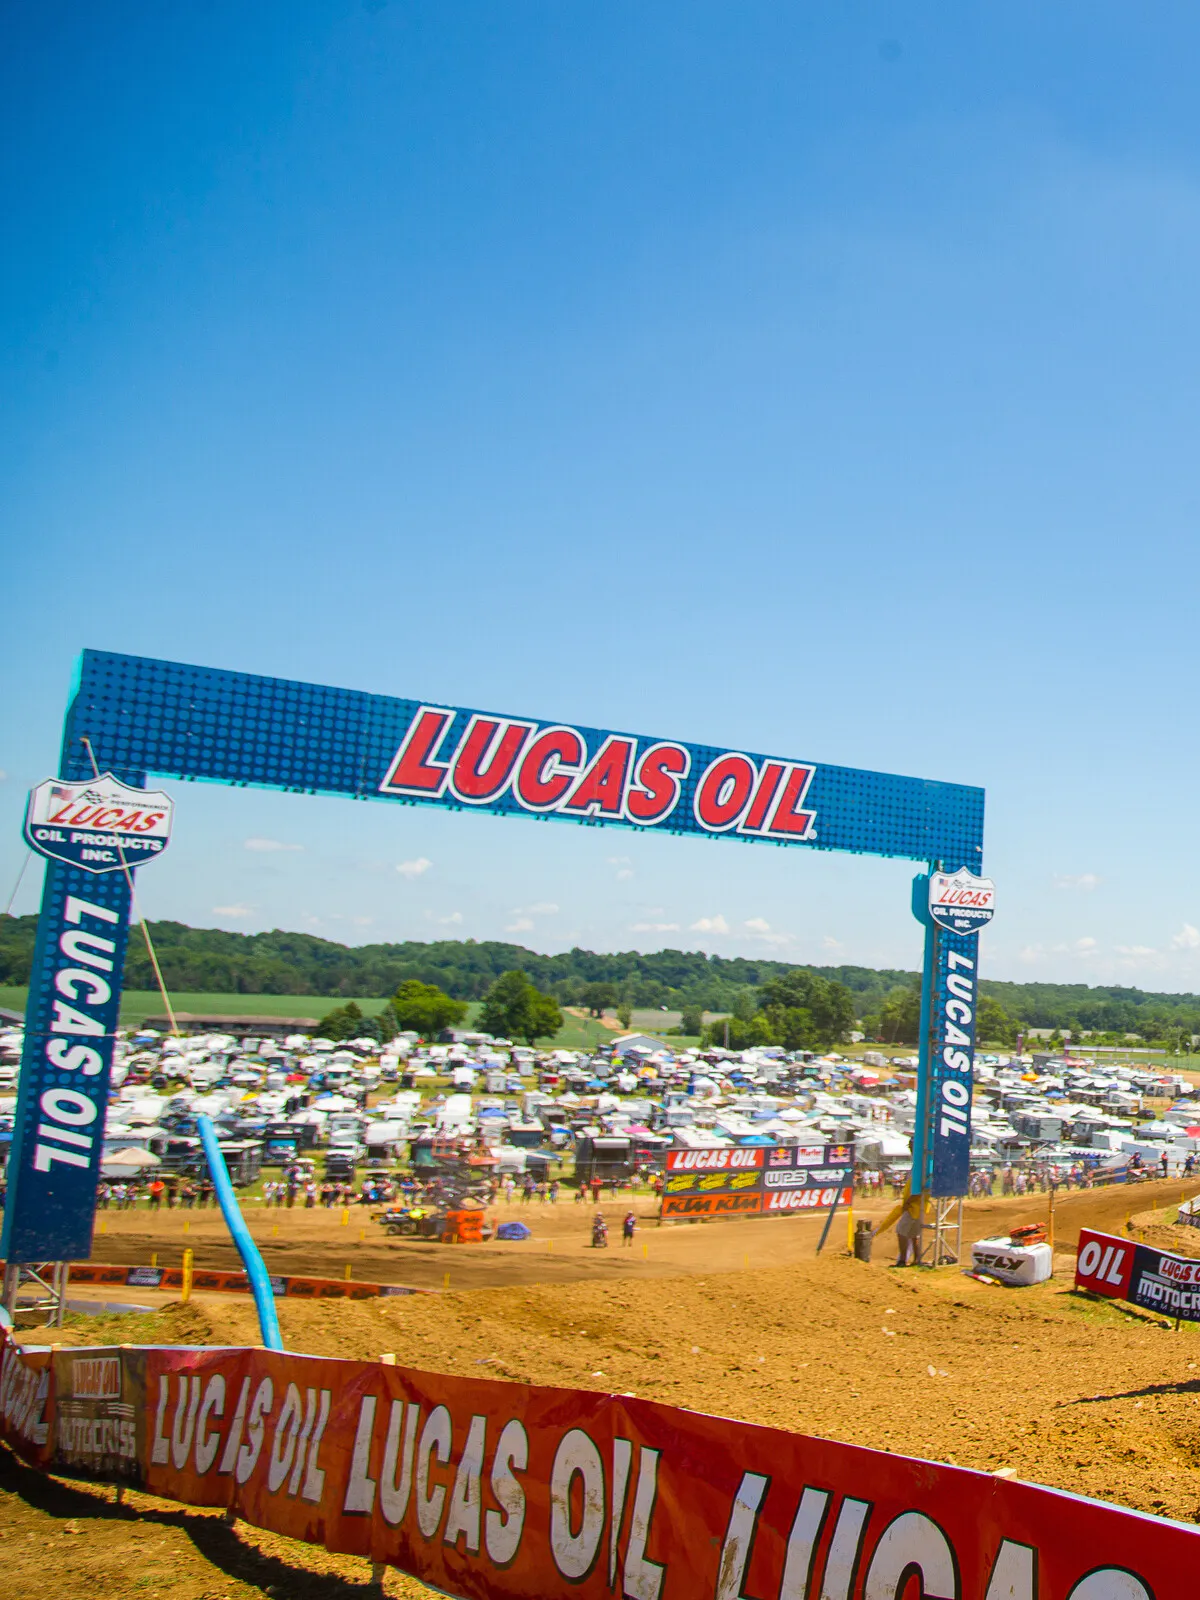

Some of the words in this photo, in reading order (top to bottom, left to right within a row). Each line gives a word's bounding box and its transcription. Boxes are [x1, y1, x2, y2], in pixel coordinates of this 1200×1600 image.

[380, 705, 692, 826] LUCAS
[693, 752, 817, 840] OIL
[46, 802, 165, 832] LUCAS
[35, 829, 67, 842] OIL
[70, 832, 163, 851] PRODUCTS
[81, 849, 117, 862] INC.
[933, 907, 948, 916] OIL
[950, 908, 992, 919] PRODUCTS
[938, 889, 992, 907] LUCAS
[45, 895, 119, 1076] LUCAS
[943, 950, 974, 1072] LUCAS
[940, 1080, 969, 1138] OIL
[33, 1088, 98, 1172] OIL
[672, 1150, 730, 1168] LUCAS
[730, 1149, 757, 1167] OIL
[666, 1197, 712, 1213] KTM
[716, 1195, 758, 1211] KTM
[769, 1190, 819, 1209] LUCAS
[821, 1188, 846, 1205] OIL
[1078, 1241, 1126, 1286] OIL
[1161, 1260, 1193, 1282] LUCAS
[268, 1382, 332, 1503] OIL
[342, 1395, 530, 1568] LUCAS
[550, 1427, 668, 1600] OIL
